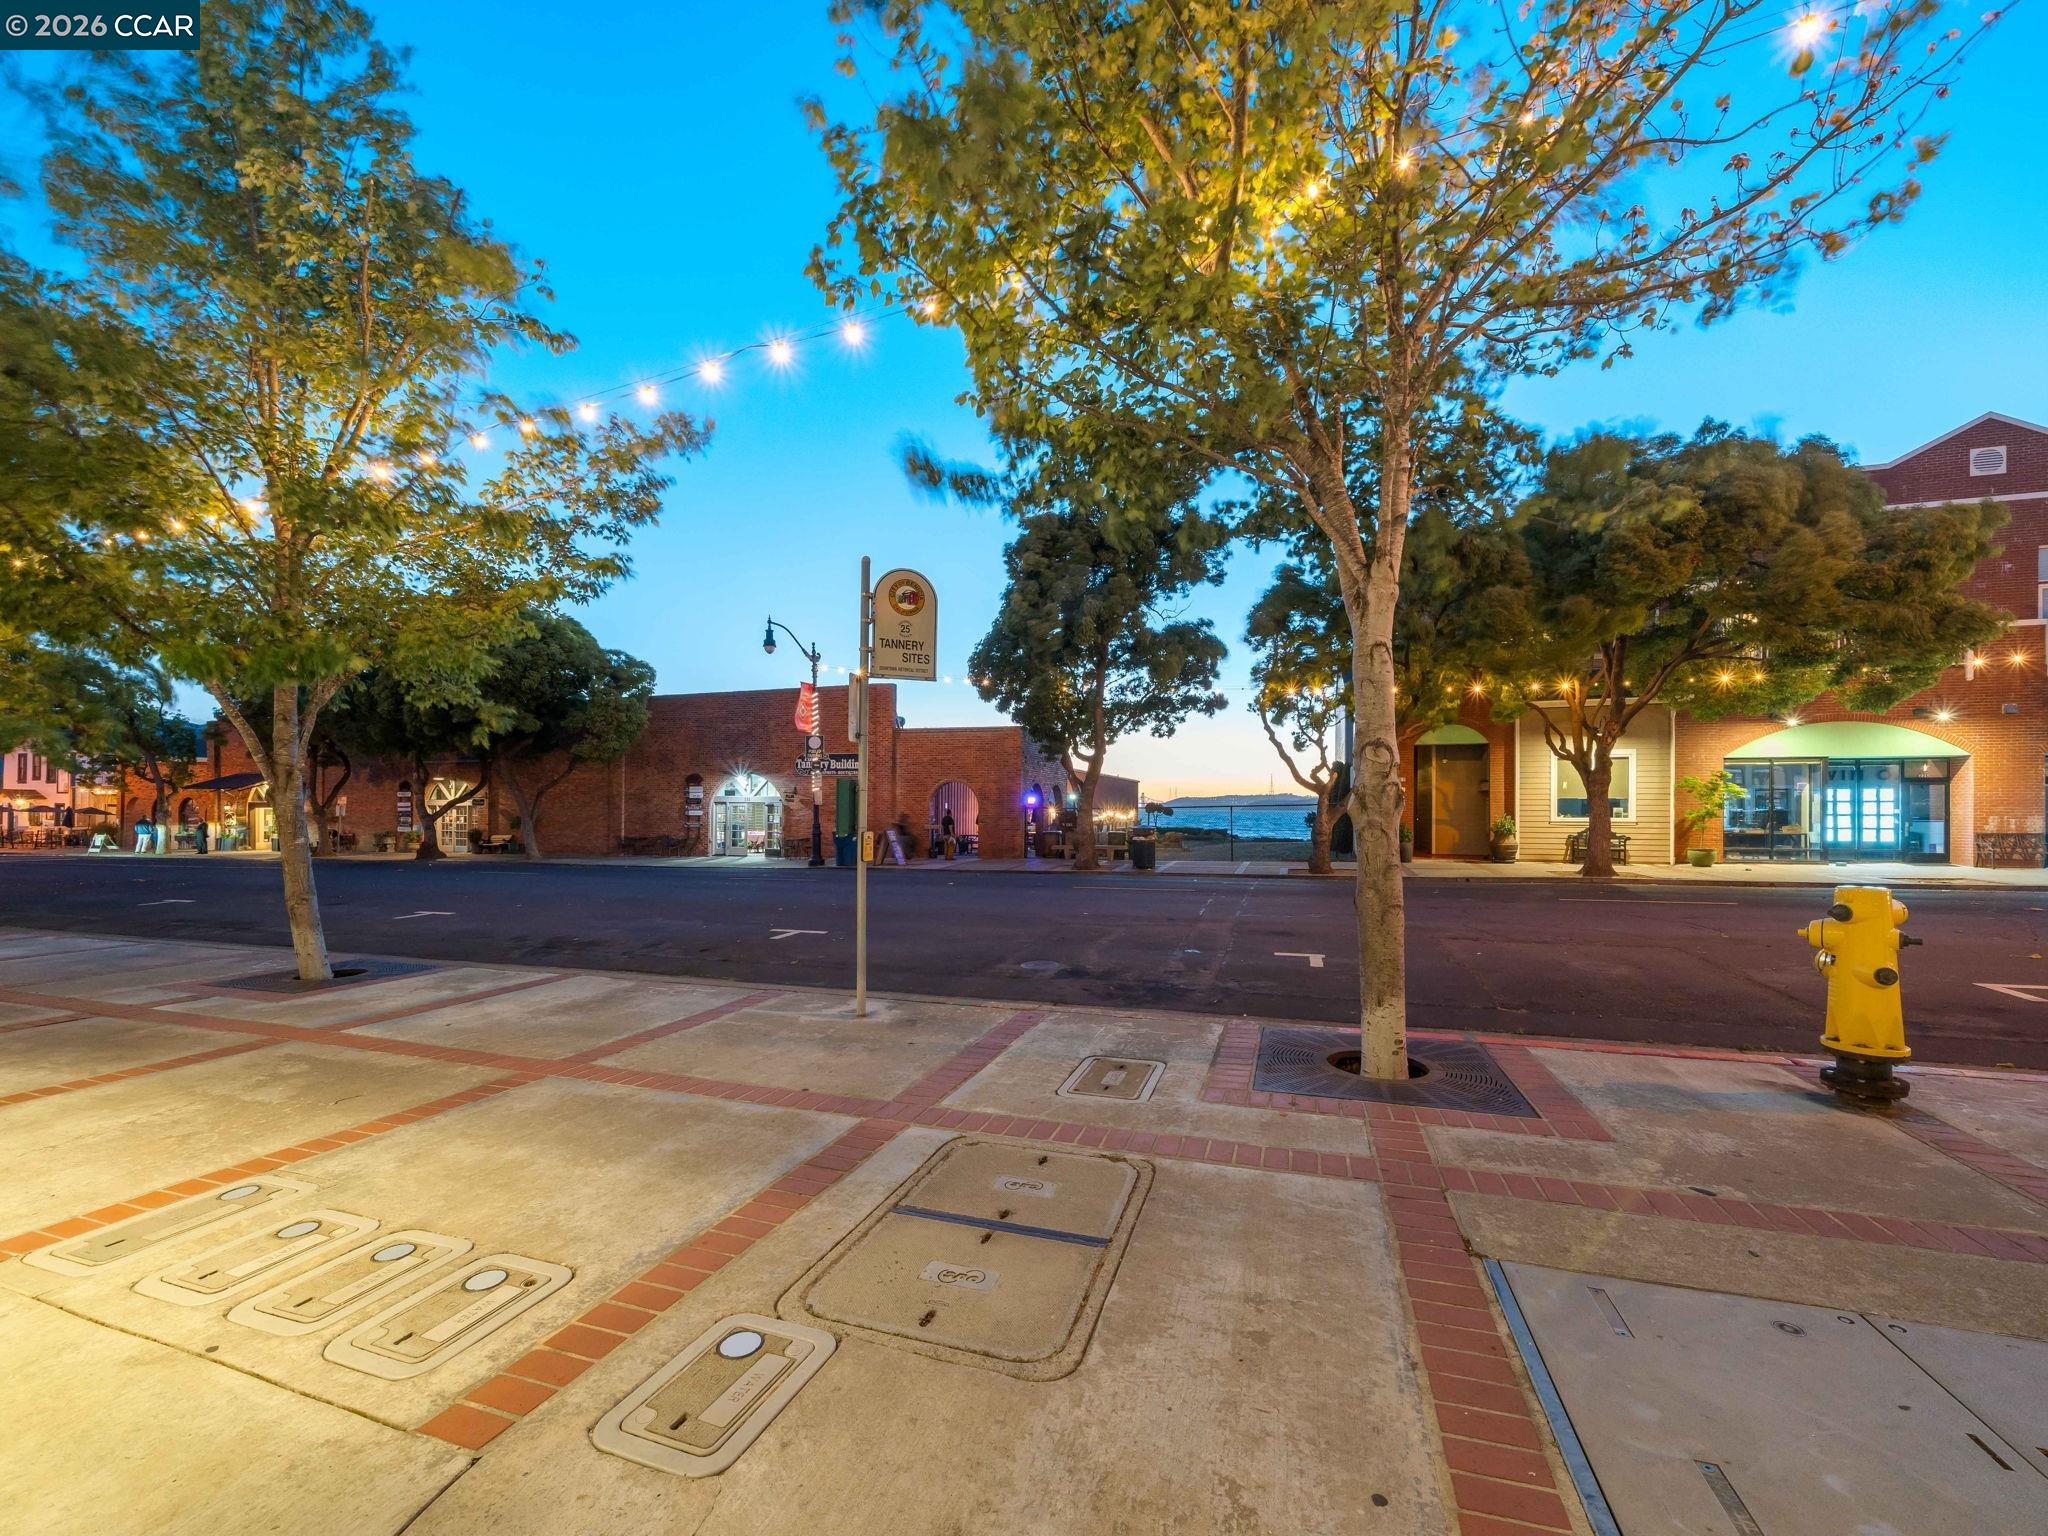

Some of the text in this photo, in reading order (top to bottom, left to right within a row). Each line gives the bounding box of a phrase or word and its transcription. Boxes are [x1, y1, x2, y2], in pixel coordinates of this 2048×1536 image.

[900, 624, 911, 634] 25
[879, 637, 924, 651] TANNERY
[902, 652, 930, 665] SITES
[797, 759, 829, 771] Tanry
[830, 758, 859, 769] Buildin
[727, 1371, 767, 1404] WATER
